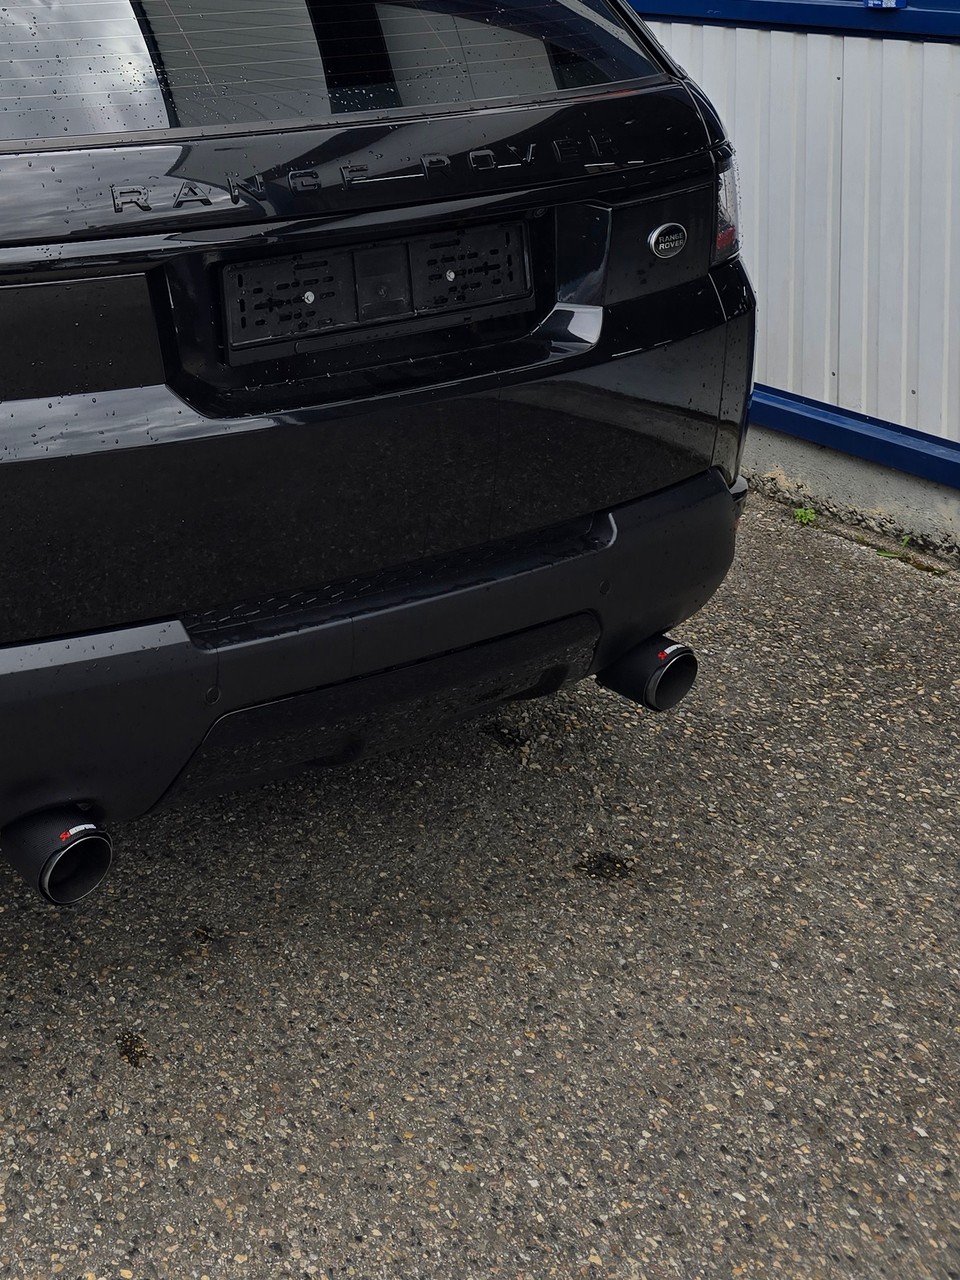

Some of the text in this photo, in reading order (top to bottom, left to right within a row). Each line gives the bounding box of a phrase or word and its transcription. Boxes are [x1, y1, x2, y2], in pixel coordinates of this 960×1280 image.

[419, 133, 620, 180] ROVER
[109, 163, 370, 213] RANGE
[658, 232, 684, 243] RANGE
[658, 239, 685, 250] ROVER
